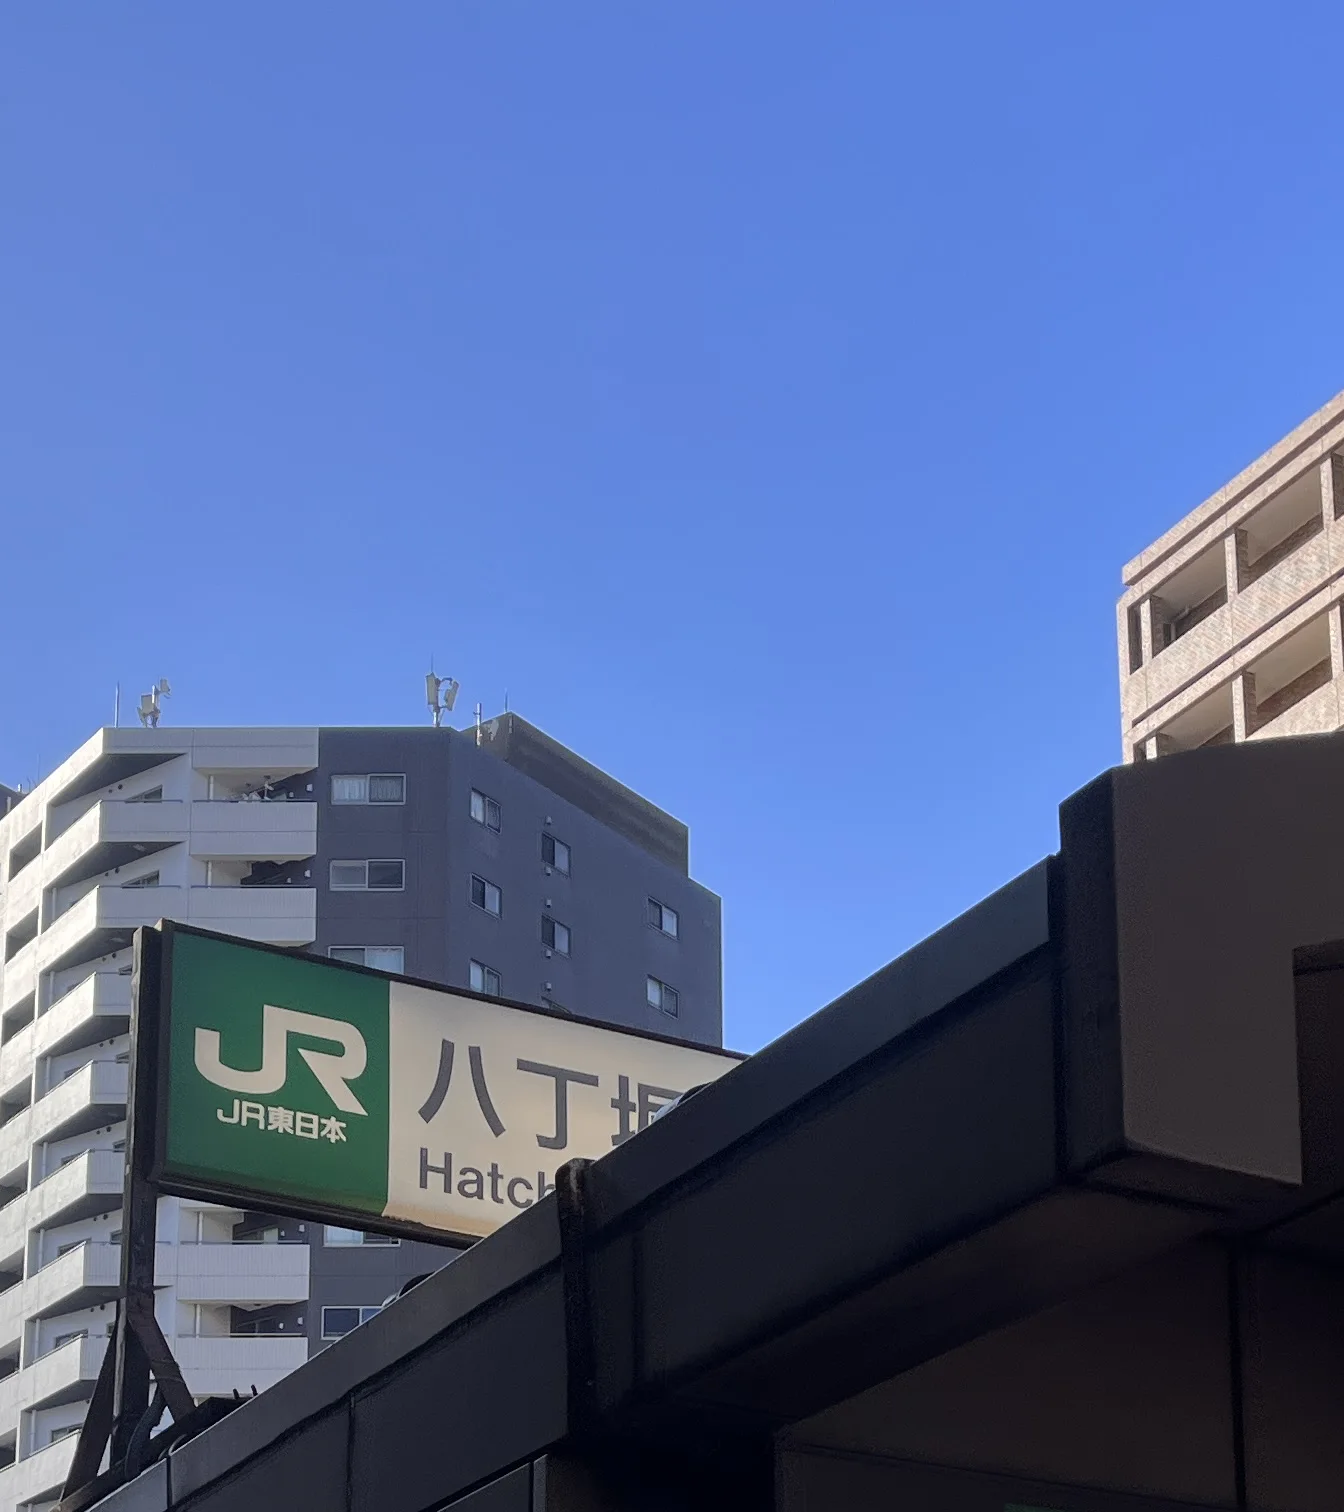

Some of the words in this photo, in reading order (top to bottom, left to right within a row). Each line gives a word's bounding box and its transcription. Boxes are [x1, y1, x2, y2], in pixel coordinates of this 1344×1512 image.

[193, 1003, 369, 1116] JR
[216, 1097, 348, 1144] JR東日本
